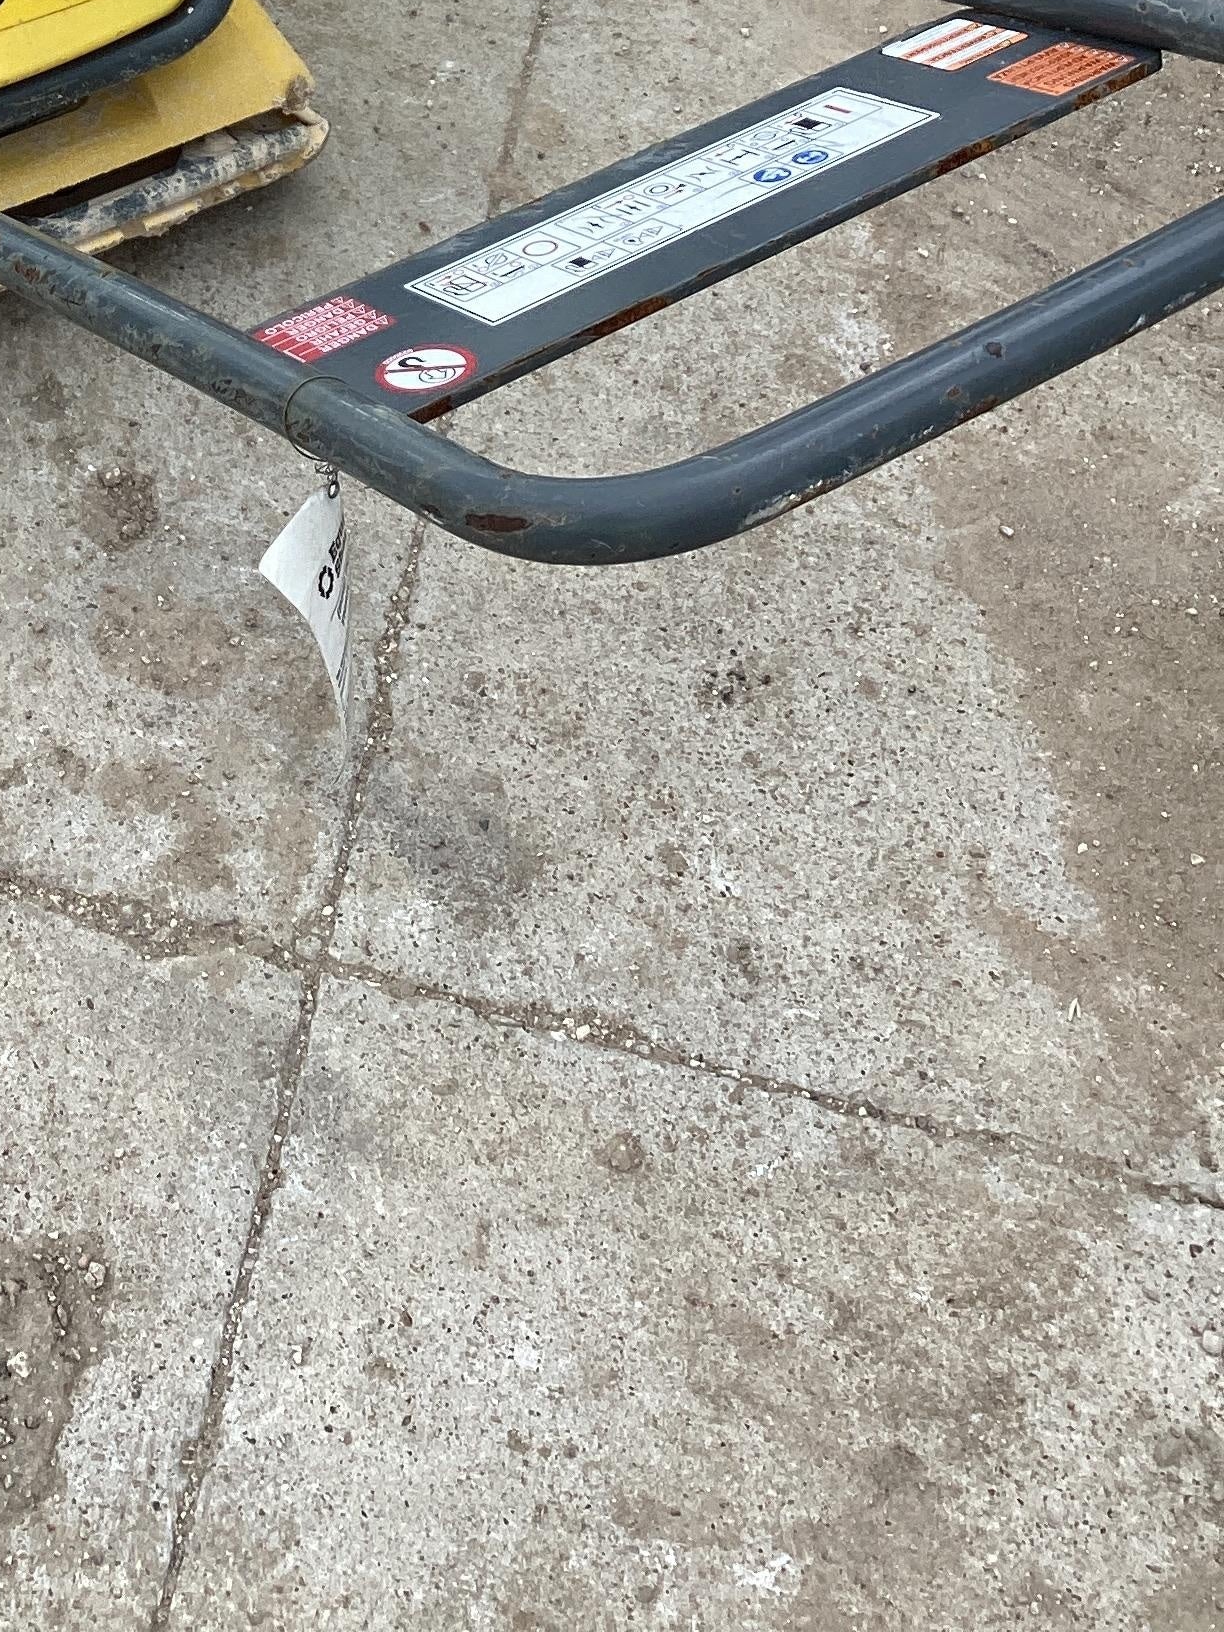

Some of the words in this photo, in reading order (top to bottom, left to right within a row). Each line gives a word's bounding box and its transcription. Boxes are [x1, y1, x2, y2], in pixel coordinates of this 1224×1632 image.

[263, 302, 333, 335] PERICOLO
[285, 307, 344, 336] DANGER
[295, 313, 356, 342] PELIGRO
[308, 318, 366, 347] GEFAHR
[317, 322, 378, 353] DANGER
